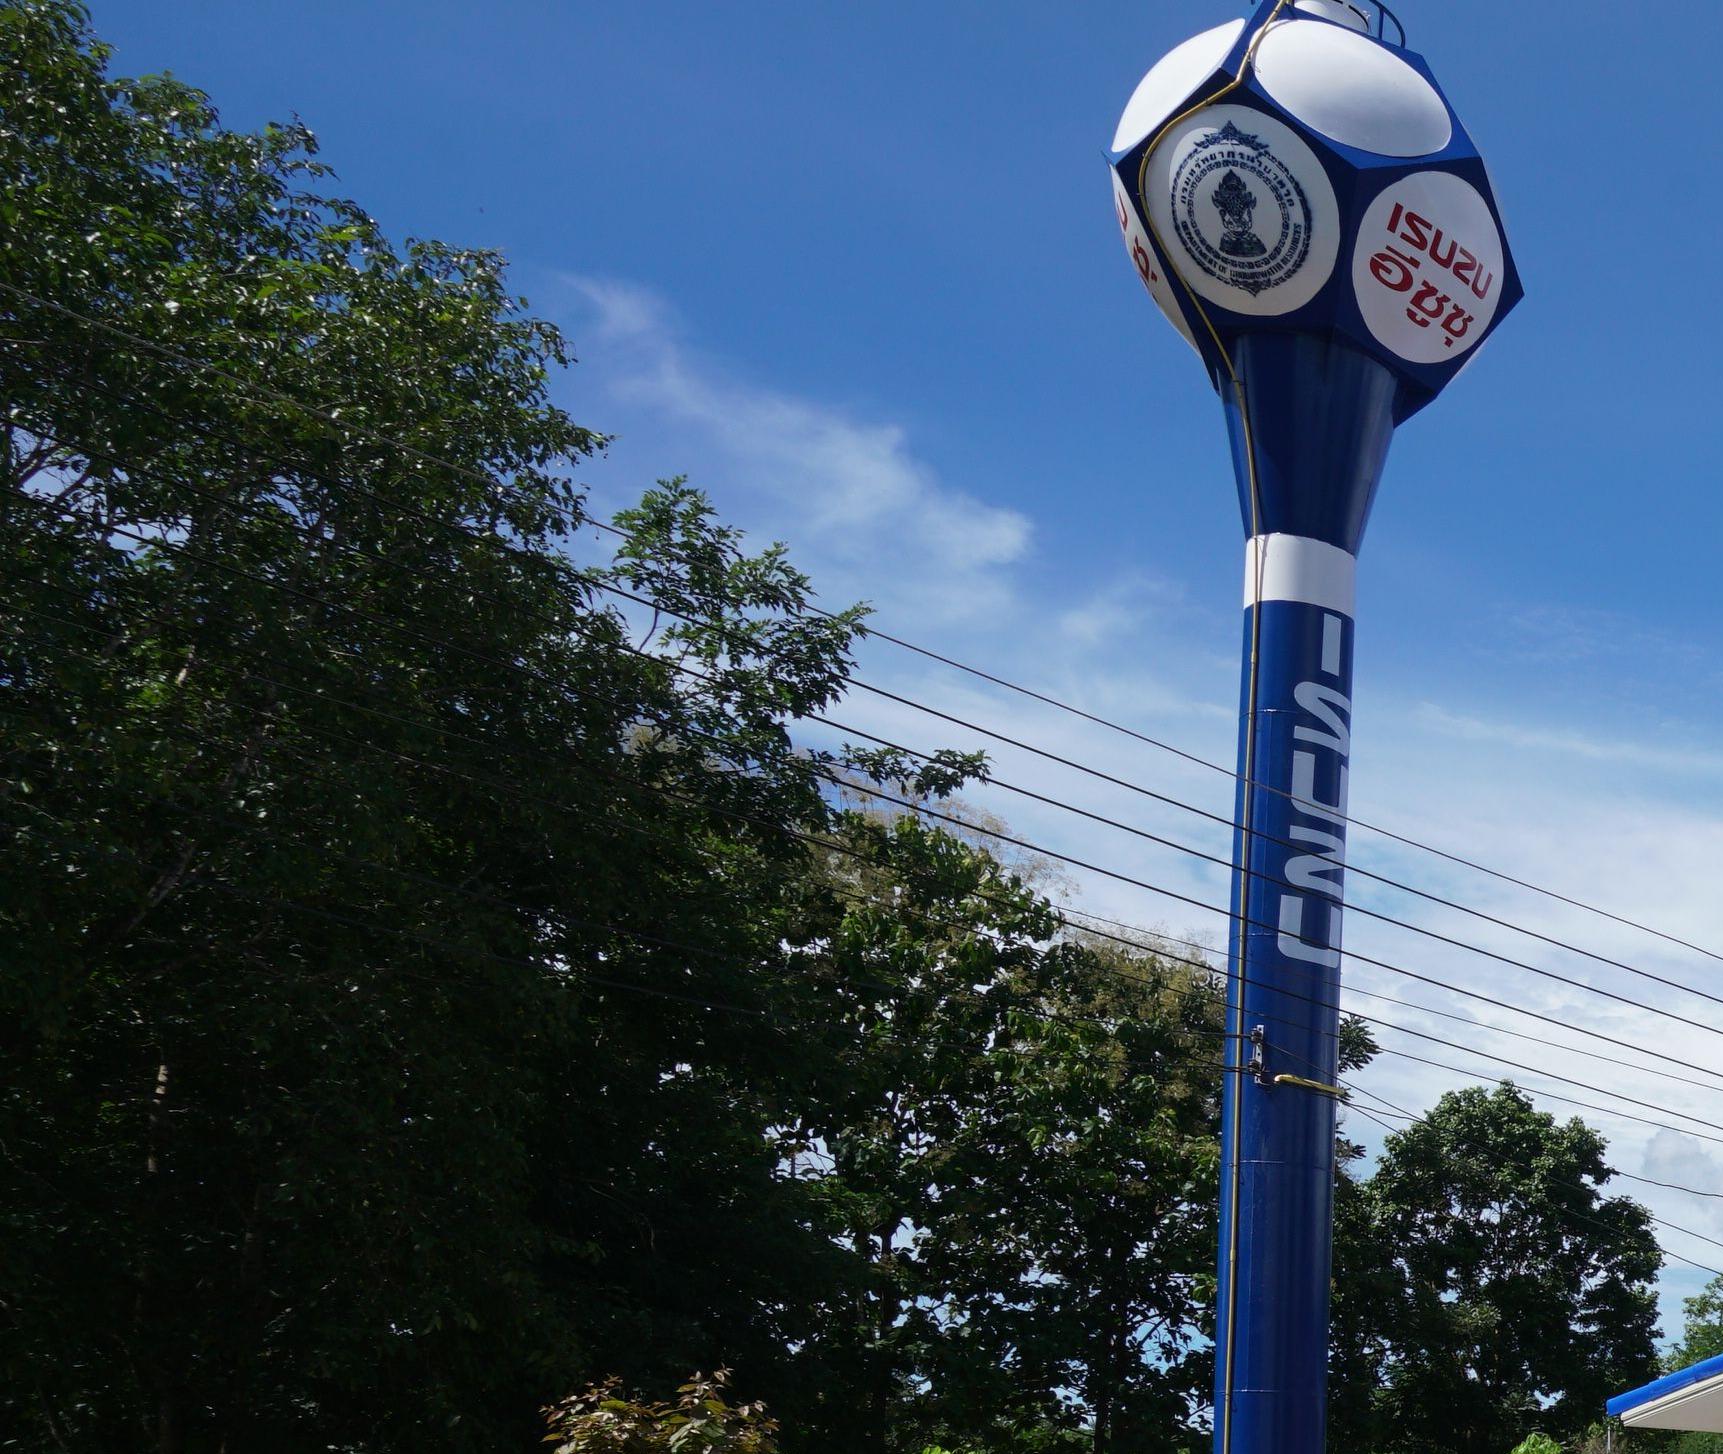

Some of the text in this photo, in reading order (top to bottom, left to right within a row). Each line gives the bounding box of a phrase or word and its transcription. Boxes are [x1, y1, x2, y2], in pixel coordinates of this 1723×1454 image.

[1369, 244, 1475, 348] อีซูซุ
[1387, 202, 1493, 300] ISUZU
[1277, 612, 1352, 969] ISUZU
